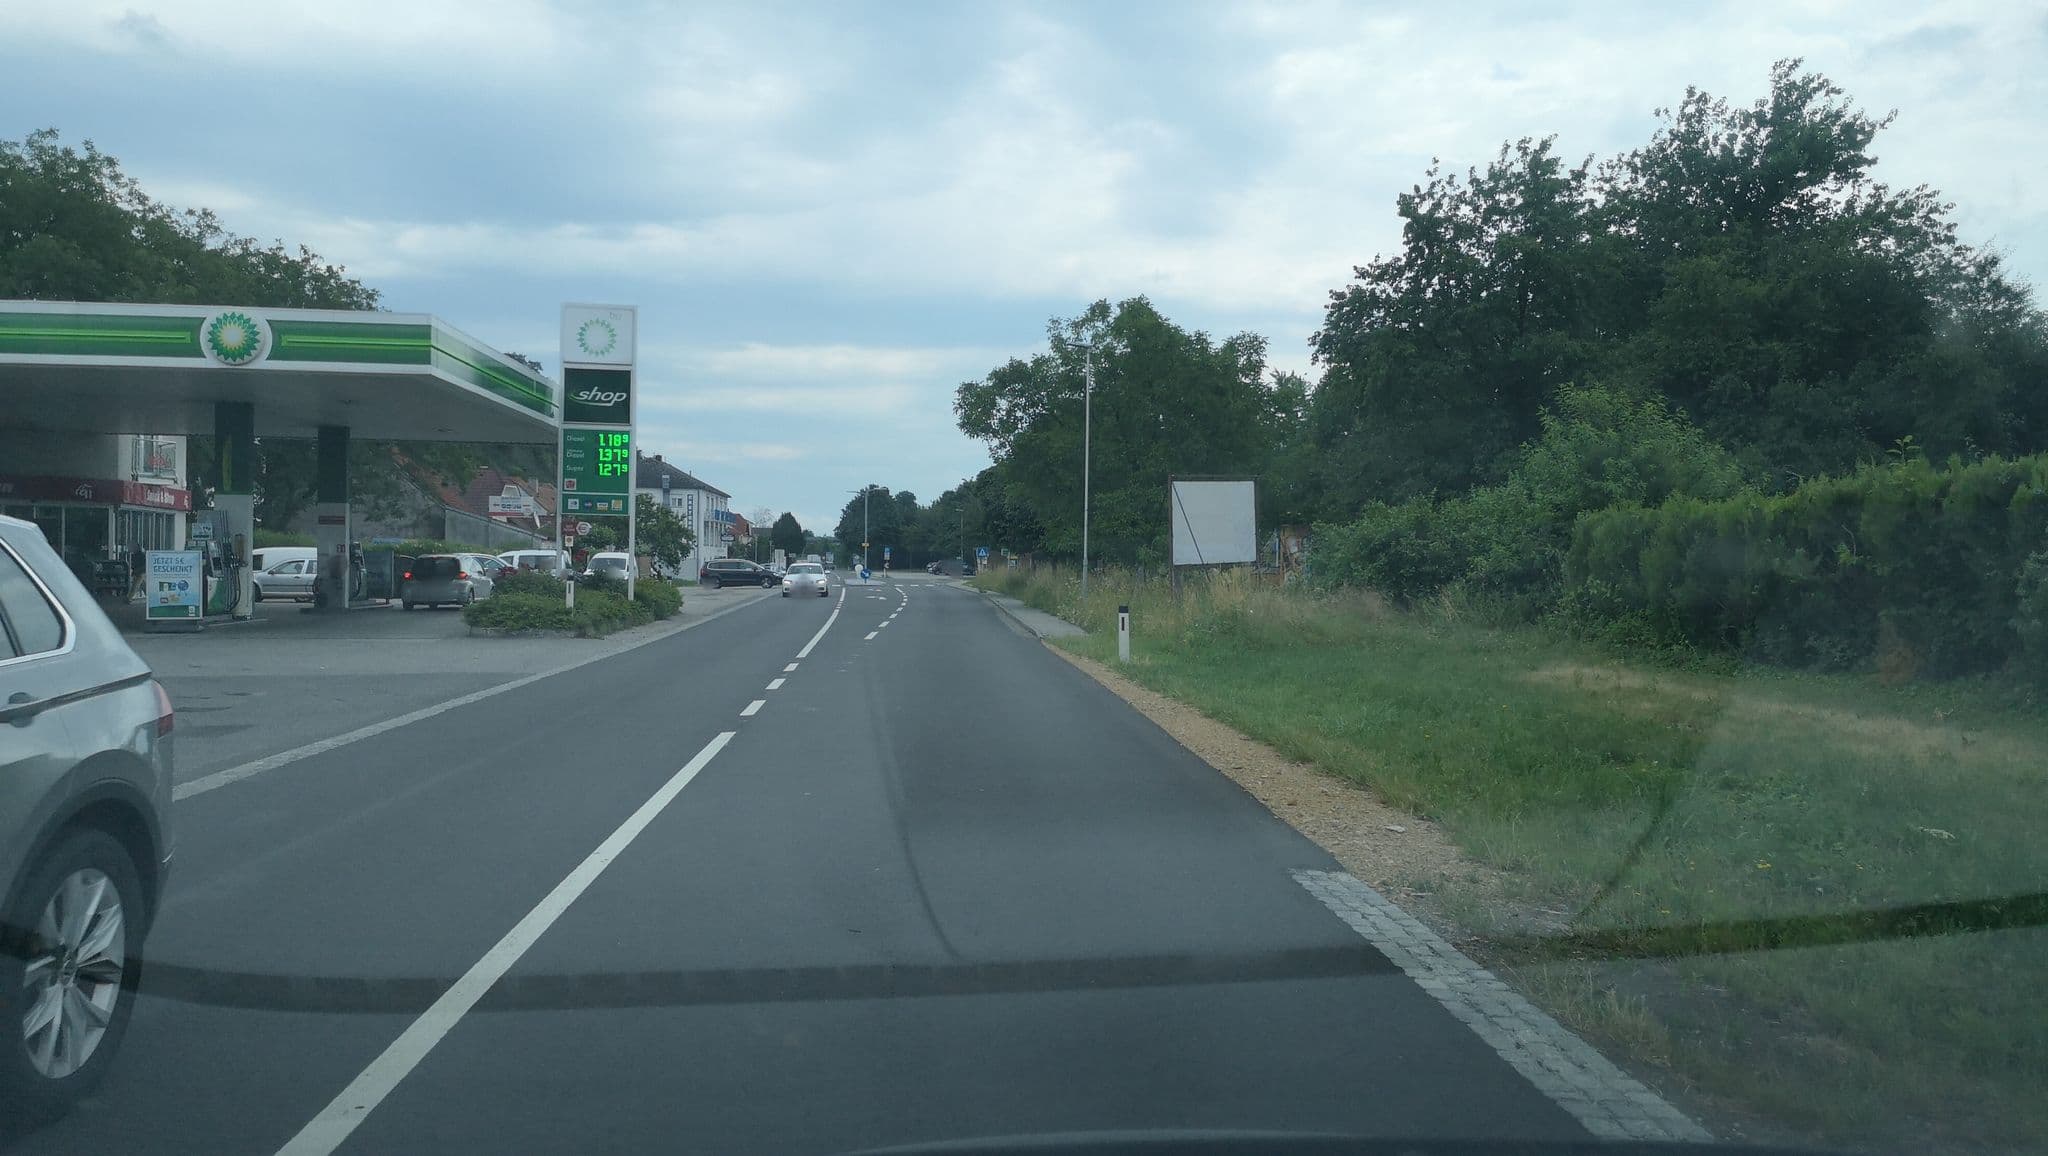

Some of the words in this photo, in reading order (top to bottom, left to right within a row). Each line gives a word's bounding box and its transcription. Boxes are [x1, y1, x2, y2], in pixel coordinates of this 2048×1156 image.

[576, 386, 628, 407] shop
[152, 557, 173, 565] JETZT
[153, 565, 193, 573] GESCHENKT
